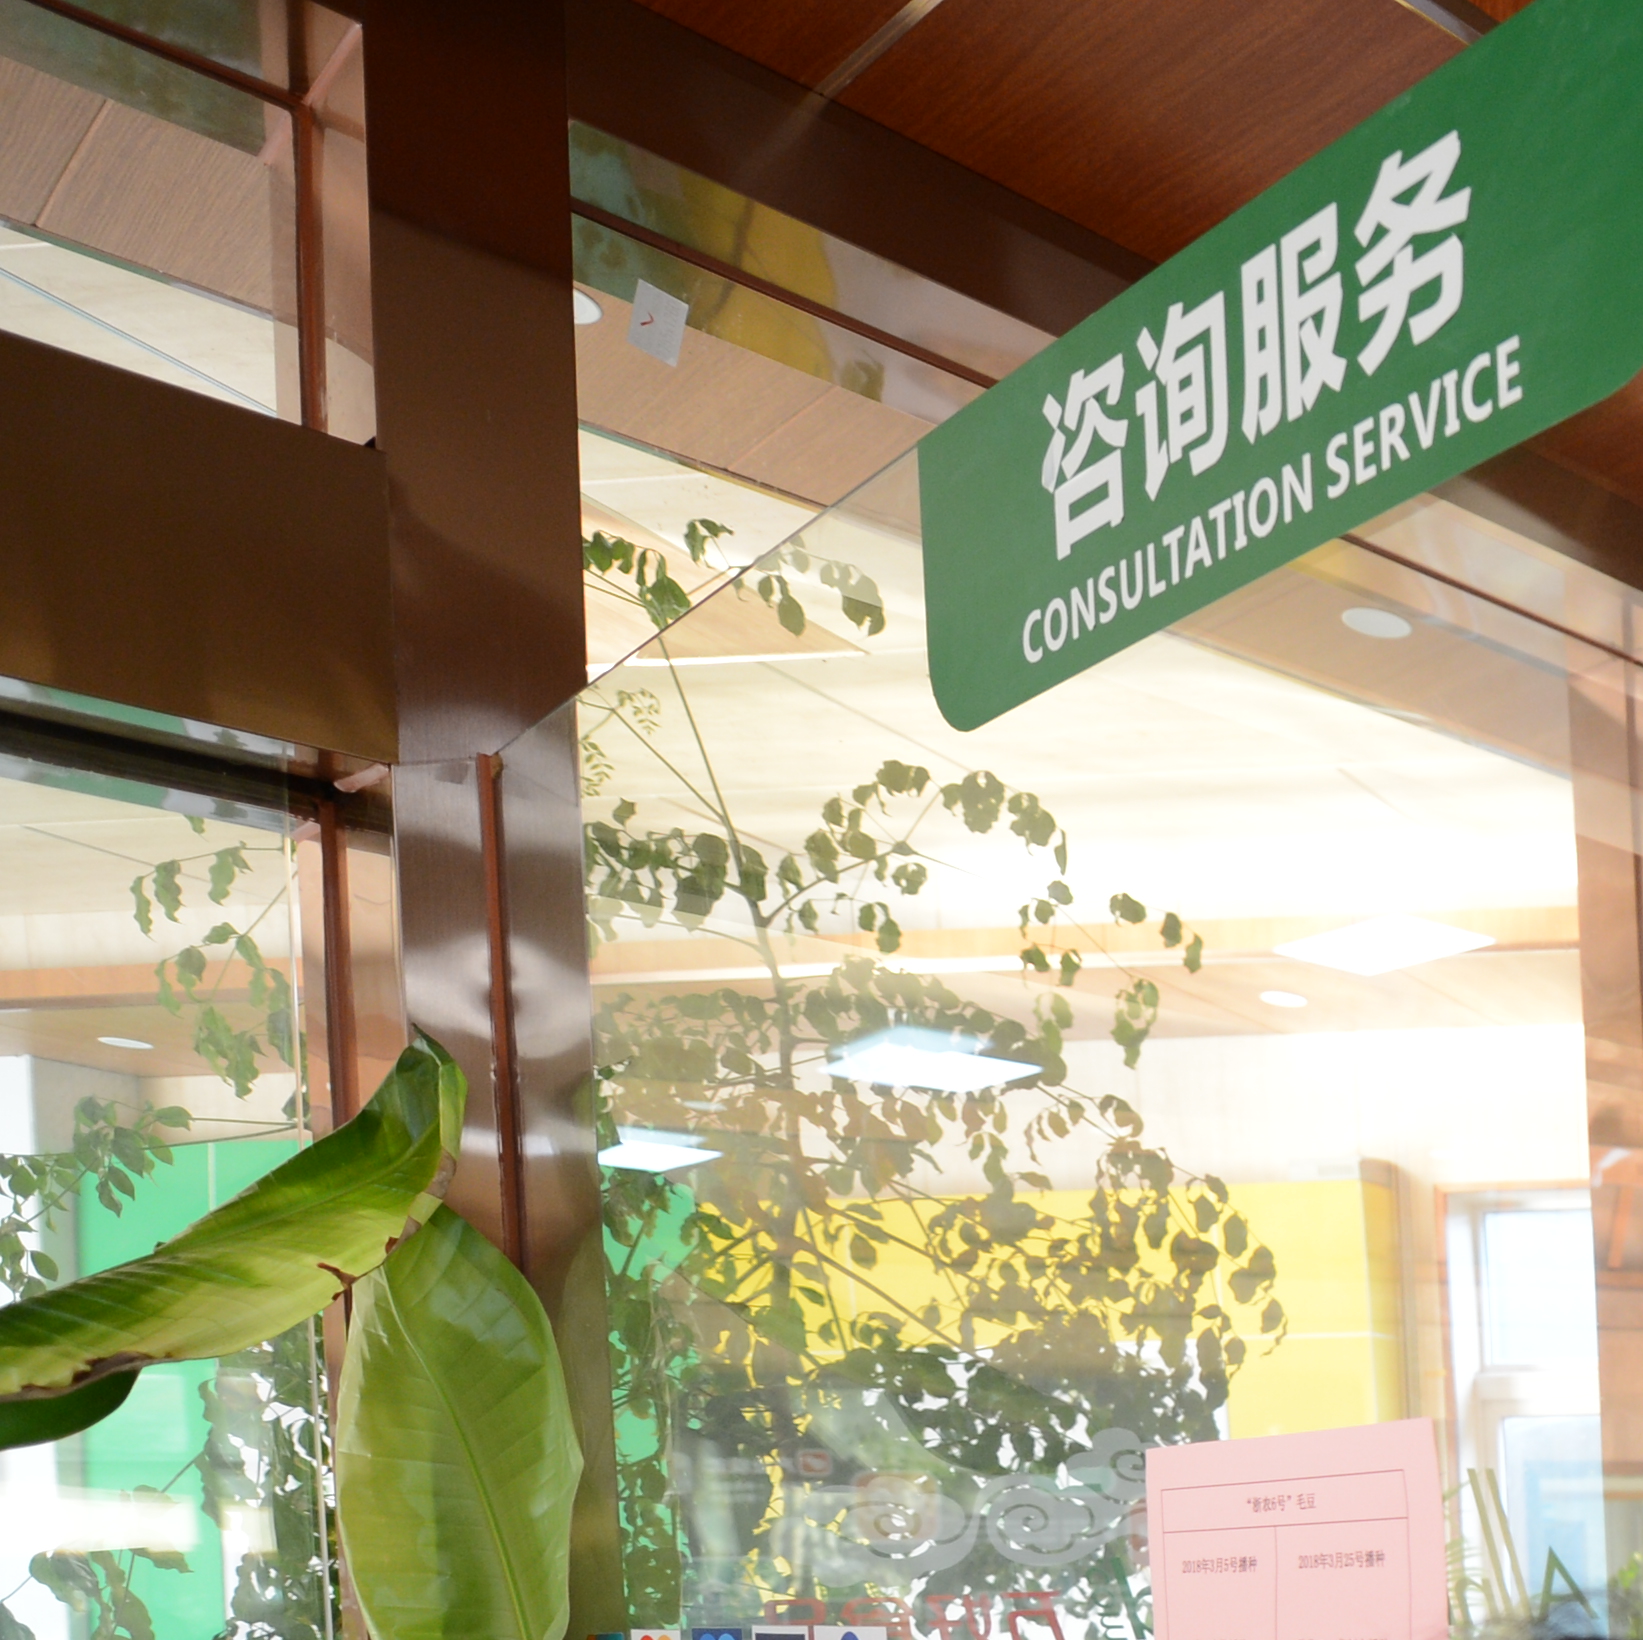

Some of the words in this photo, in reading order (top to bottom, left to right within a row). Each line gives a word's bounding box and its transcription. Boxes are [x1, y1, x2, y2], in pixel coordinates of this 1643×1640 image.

[1021, 453, 1313, 663] CONSULTATION
[1325, 335, 1524, 500] SERVICE
[1041, 129, 1471, 560] 咨询服务
